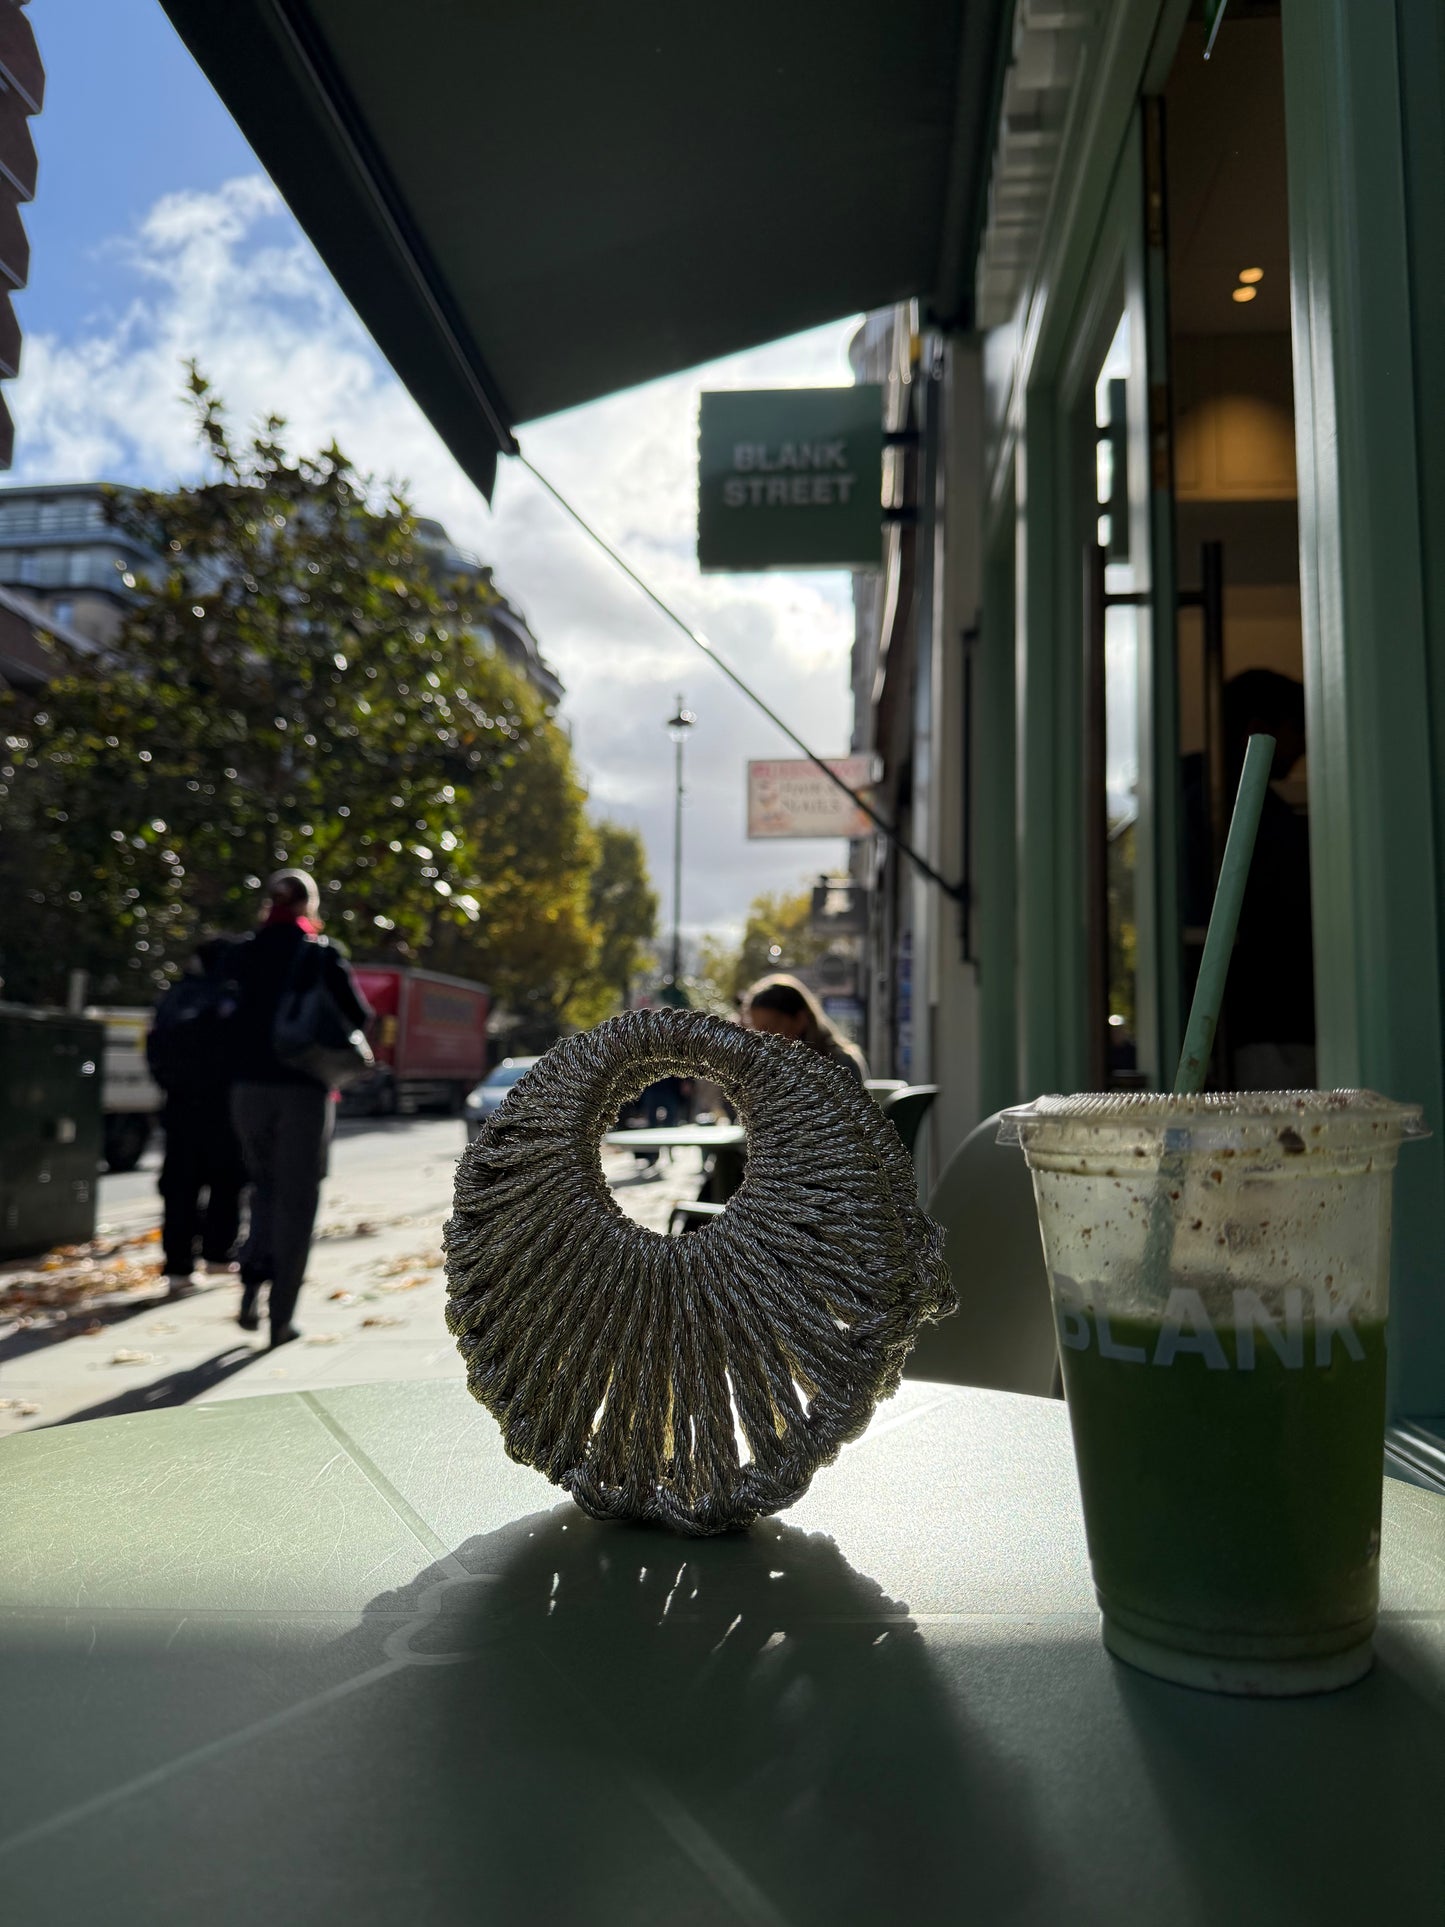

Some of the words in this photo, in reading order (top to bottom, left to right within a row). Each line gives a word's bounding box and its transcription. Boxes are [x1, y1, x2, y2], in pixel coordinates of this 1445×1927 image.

[733, 442, 848, 471] BLANK
[723, 475, 855, 506] STREET
[1052, 1271, 1367, 1371] BLANK
